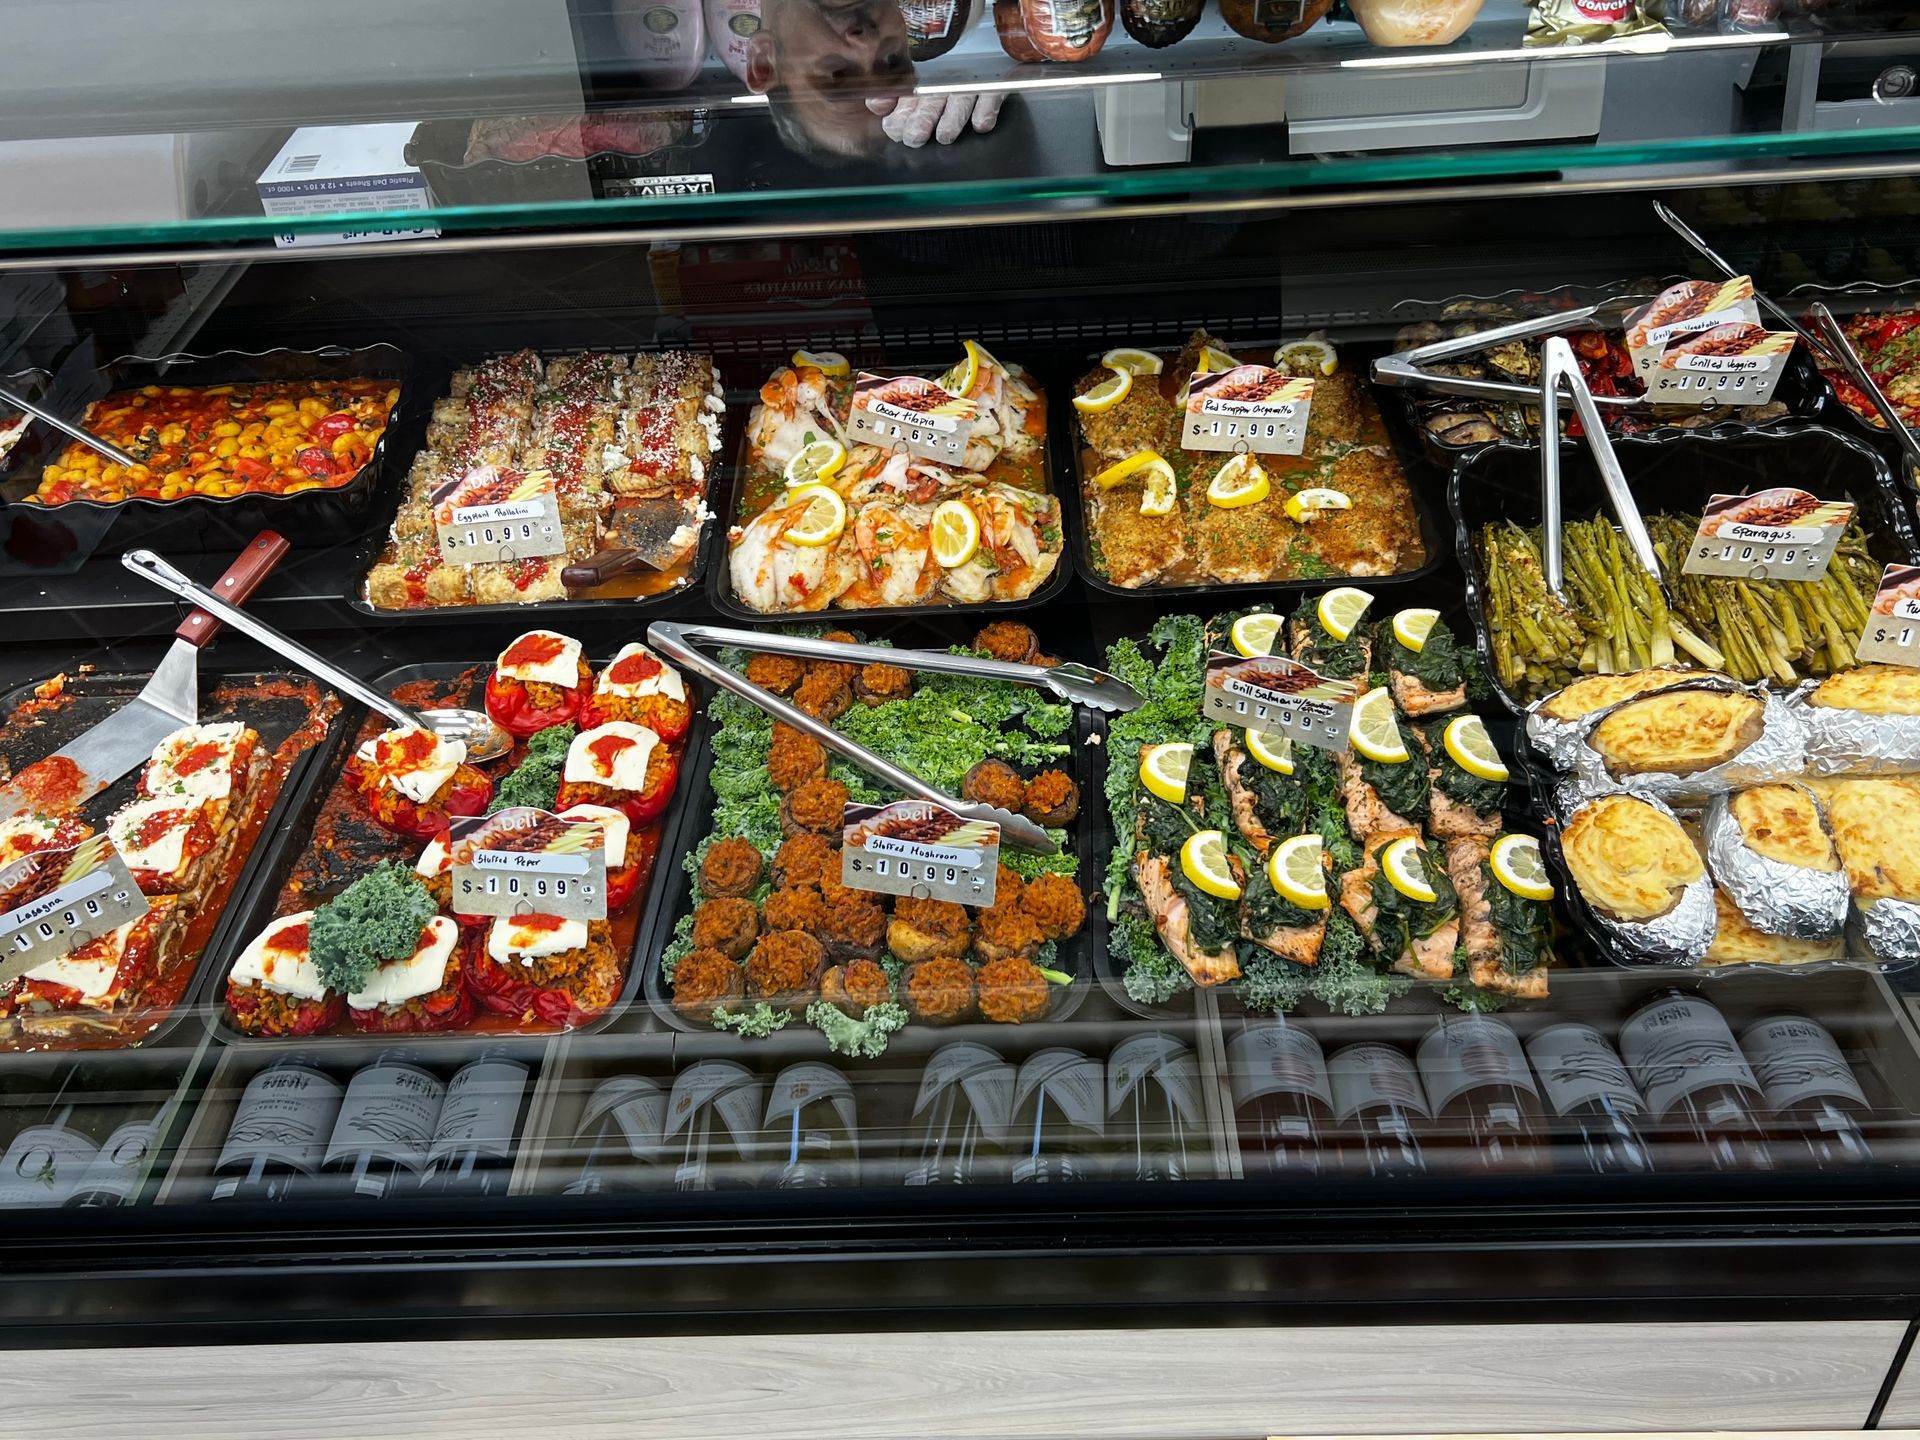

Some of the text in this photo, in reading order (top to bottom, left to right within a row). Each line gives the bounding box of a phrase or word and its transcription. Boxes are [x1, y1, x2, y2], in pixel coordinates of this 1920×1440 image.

[346, 179, 371, 188] Sheets
[373, 178, 387, 187] Deli
[389, 177, 414, 186] Plastic
[1713, 325, 1745, 340] Deli
[1690, 356, 1722, 368] Grilled
[1234, 370, 1263, 385] Deli
[899, 383, 928, 396] Deli
[1205, 399, 1219, 411] Red
[471, 468, 500, 488] Deli
[1759, 493, 1795, 508] Deli
[1258, 663, 1293, 676] Deli
[1232, 680, 1253, 696] Grill
[1255, 688, 1291, 705] Salmon
[500, 811, 538, 831] Deli
[897, 806, 934, 821] Deli
[911, 845, 958, 861] Mushroom
[514, 855, 542, 867] Peper
[3, 857, 41, 889] Deli
[16, 898, 63, 924] Lasagna
